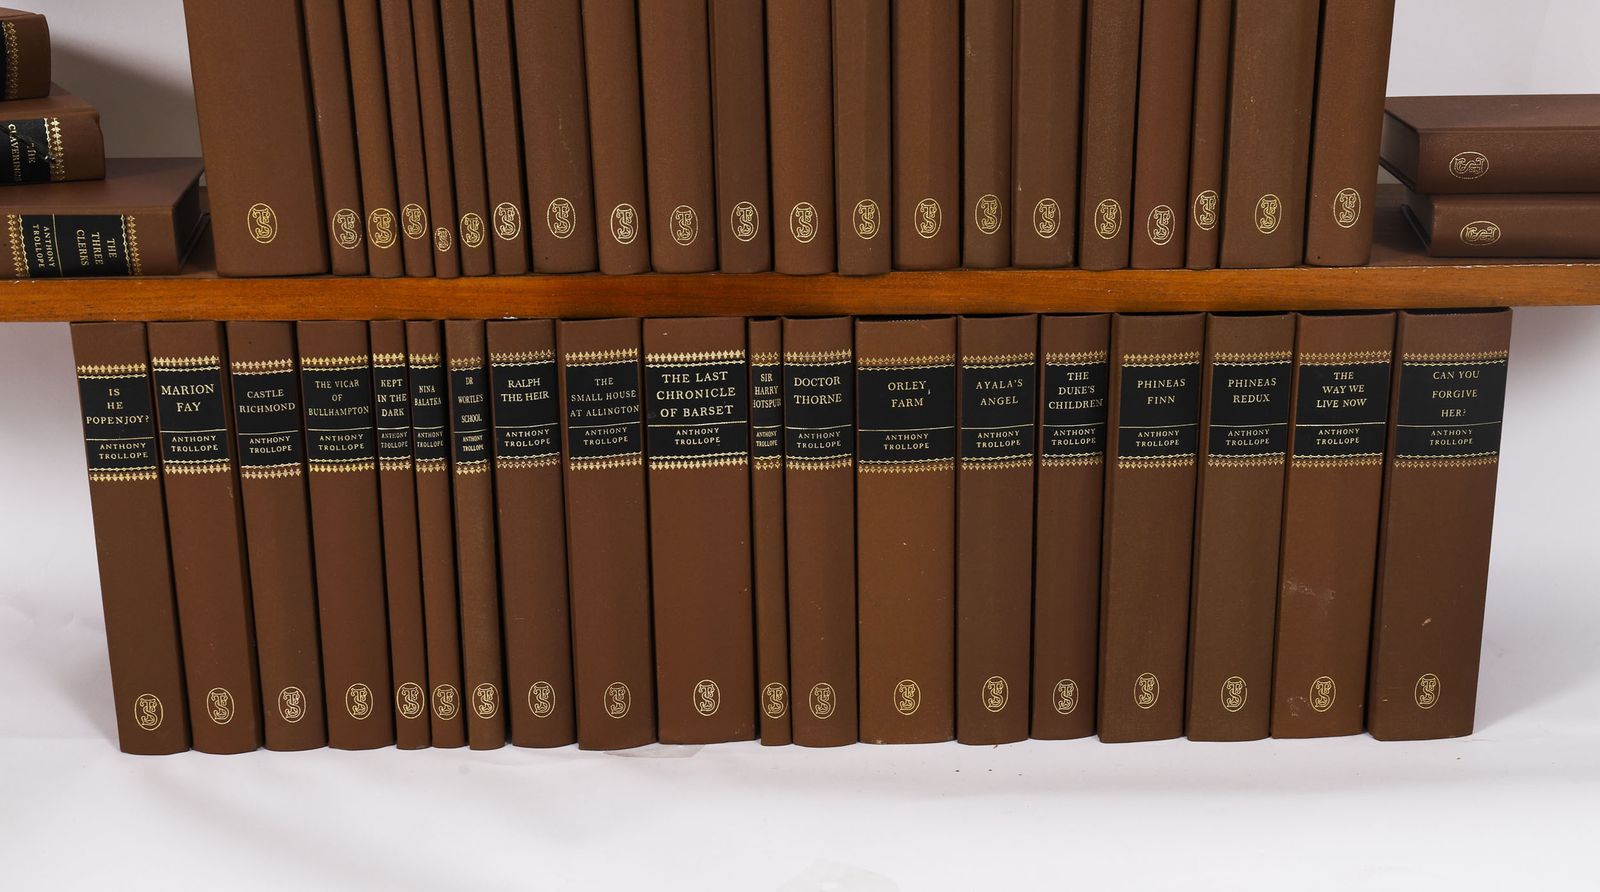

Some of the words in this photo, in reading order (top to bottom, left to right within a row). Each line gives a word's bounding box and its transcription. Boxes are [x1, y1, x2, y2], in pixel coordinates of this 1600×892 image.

[8, 123, 22, 181] CLAVERING
[33, 224, 45, 268] TROLLOPE
[44, 226, 55, 267] ANTHONY
[77, 229, 89, 266] CLERKS
[91, 232, 103, 264] THREE
[107, 238, 117, 258] THE
[662, 374, 690, 383] THE
[696, 371, 728, 382] LAST
[761, 373, 773, 382] SIR
[1067, 372, 1089, 381] THE
[1334, 372, 1354, 380] THE
[1433, 371, 1454, 380] CAN
[1459, 371, 1480, 379] YOU
[335, 379, 359, 387] VICAR
[381, 379, 403, 387] KEPT
[466, 377, 473, 385] DR
[508, 378, 541, 388] RALPH
[594, 377, 614, 386] THE
[794, 376, 841, 386] DOCTOR
[888, 380, 927, 391] ORLEY
[976, 379, 1023, 390] AYALA'S
[1138, 378, 1186, 388] PHINEAS
[1228, 378, 1277, 388] PHINEAS
[161, 384, 214, 395] MARION
[247, 389, 284, 398] CASTLE
[419, 385, 435, 393] NINA
[657, 387, 736, 400] CHRONICLE
[754, 385, 779, 395] HARRY
[1058, 385, 1096, 395] DUKE'S
[1322, 386, 1346, 394] WAY
[1349, 385, 1365, 393] WE
[390, 394, 407, 402] THE
[501, 393, 522, 402] THE
[525, 391, 549, 401] HEIR
[571, 394, 603, 402] SMALL
[606, 390, 637, 400] HOUSE
[1233, 394, 1270, 403] REDUX
[1432, 390, 1478, 398] FORGIVE
[414, 398, 441, 406] BALATKA
[794, 394, 842, 405] THORNE
[891, 398, 924, 408] FARM
[981, 397, 1019, 406] ANGEL
[1048, 399, 1103, 409] CHILDREN
[1147, 395, 1175, 405] FINN
[1317, 399, 1339, 408] LIVE
[1343, 399, 1367, 407] NOW
[177, 402, 201, 412] FAY
[239, 403, 295, 413] RICHMOND
[308, 406, 369, 416] BULLHAMPTON
[586, 405, 640, 416] ALLINGTON
[660, 408, 677, 417] OF
[683, 405, 734, 417] BARSET
[381, 408, 404, 416] DARK
[1441, 409, 1466, 418] HER?
[86, 416, 149, 424] POPENJOY?
[461, 414, 482, 423] SCHOOL
[506, 429, 550, 437] ANTHONY
[585, 427, 628, 436] ANTHONY
[676, 428, 719, 436] ANTHONY
[798, 431, 841, 439] ANTHONY
[978, 431, 1020, 439] ANTHONY
[1054, 428, 1096, 436] ANTHONY
[1138, 430, 1180, 438] ANTHONY
[1228, 429, 1270, 437] ANTHONY
[250, 436, 290, 444] ANTHONY
[584, 436, 628, 445] TROLLOPE
[675, 437, 721, 445] TROLLOPE
[885, 433, 929, 441] ANTHONY
[1052, 437, 1096, 445] TROLLOPE
[1316, 437, 1360, 445] TROLLOPE
[504, 438, 551, 447] TROLLOPE
[796, 441, 841, 449] TROLLOPE
[976, 440, 1021, 448] TROLLOPE
[1136, 439, 1179, 447] TROLLOPE
[1226, 438, 1270, 446] TROLLOPE
[1430, 438, 1473, 446] TROLLOPE
[250, 445, 292, 453] TROLLOPE
[318, 443, 364, 451] TROLLOPE
